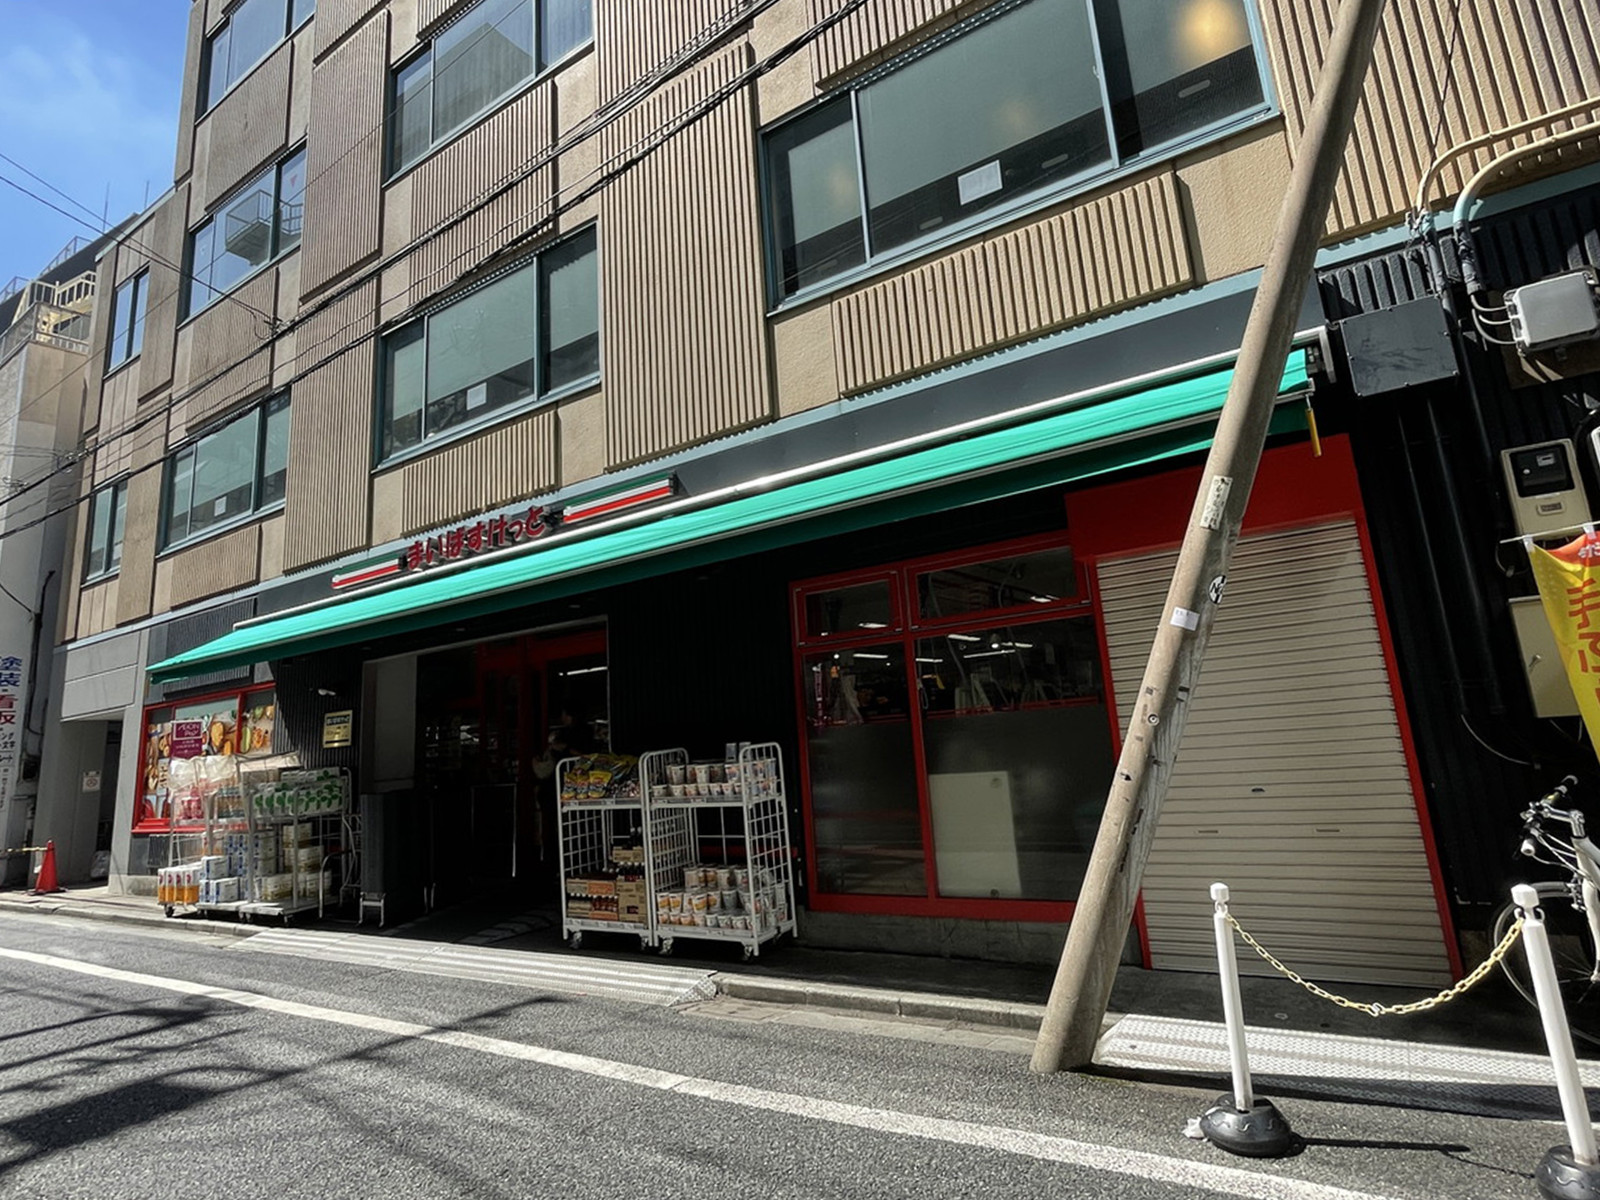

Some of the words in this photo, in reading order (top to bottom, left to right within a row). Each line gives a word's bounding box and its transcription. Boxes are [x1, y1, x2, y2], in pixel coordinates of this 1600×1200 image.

[408, 505, 547, 571] まいばすけっと
